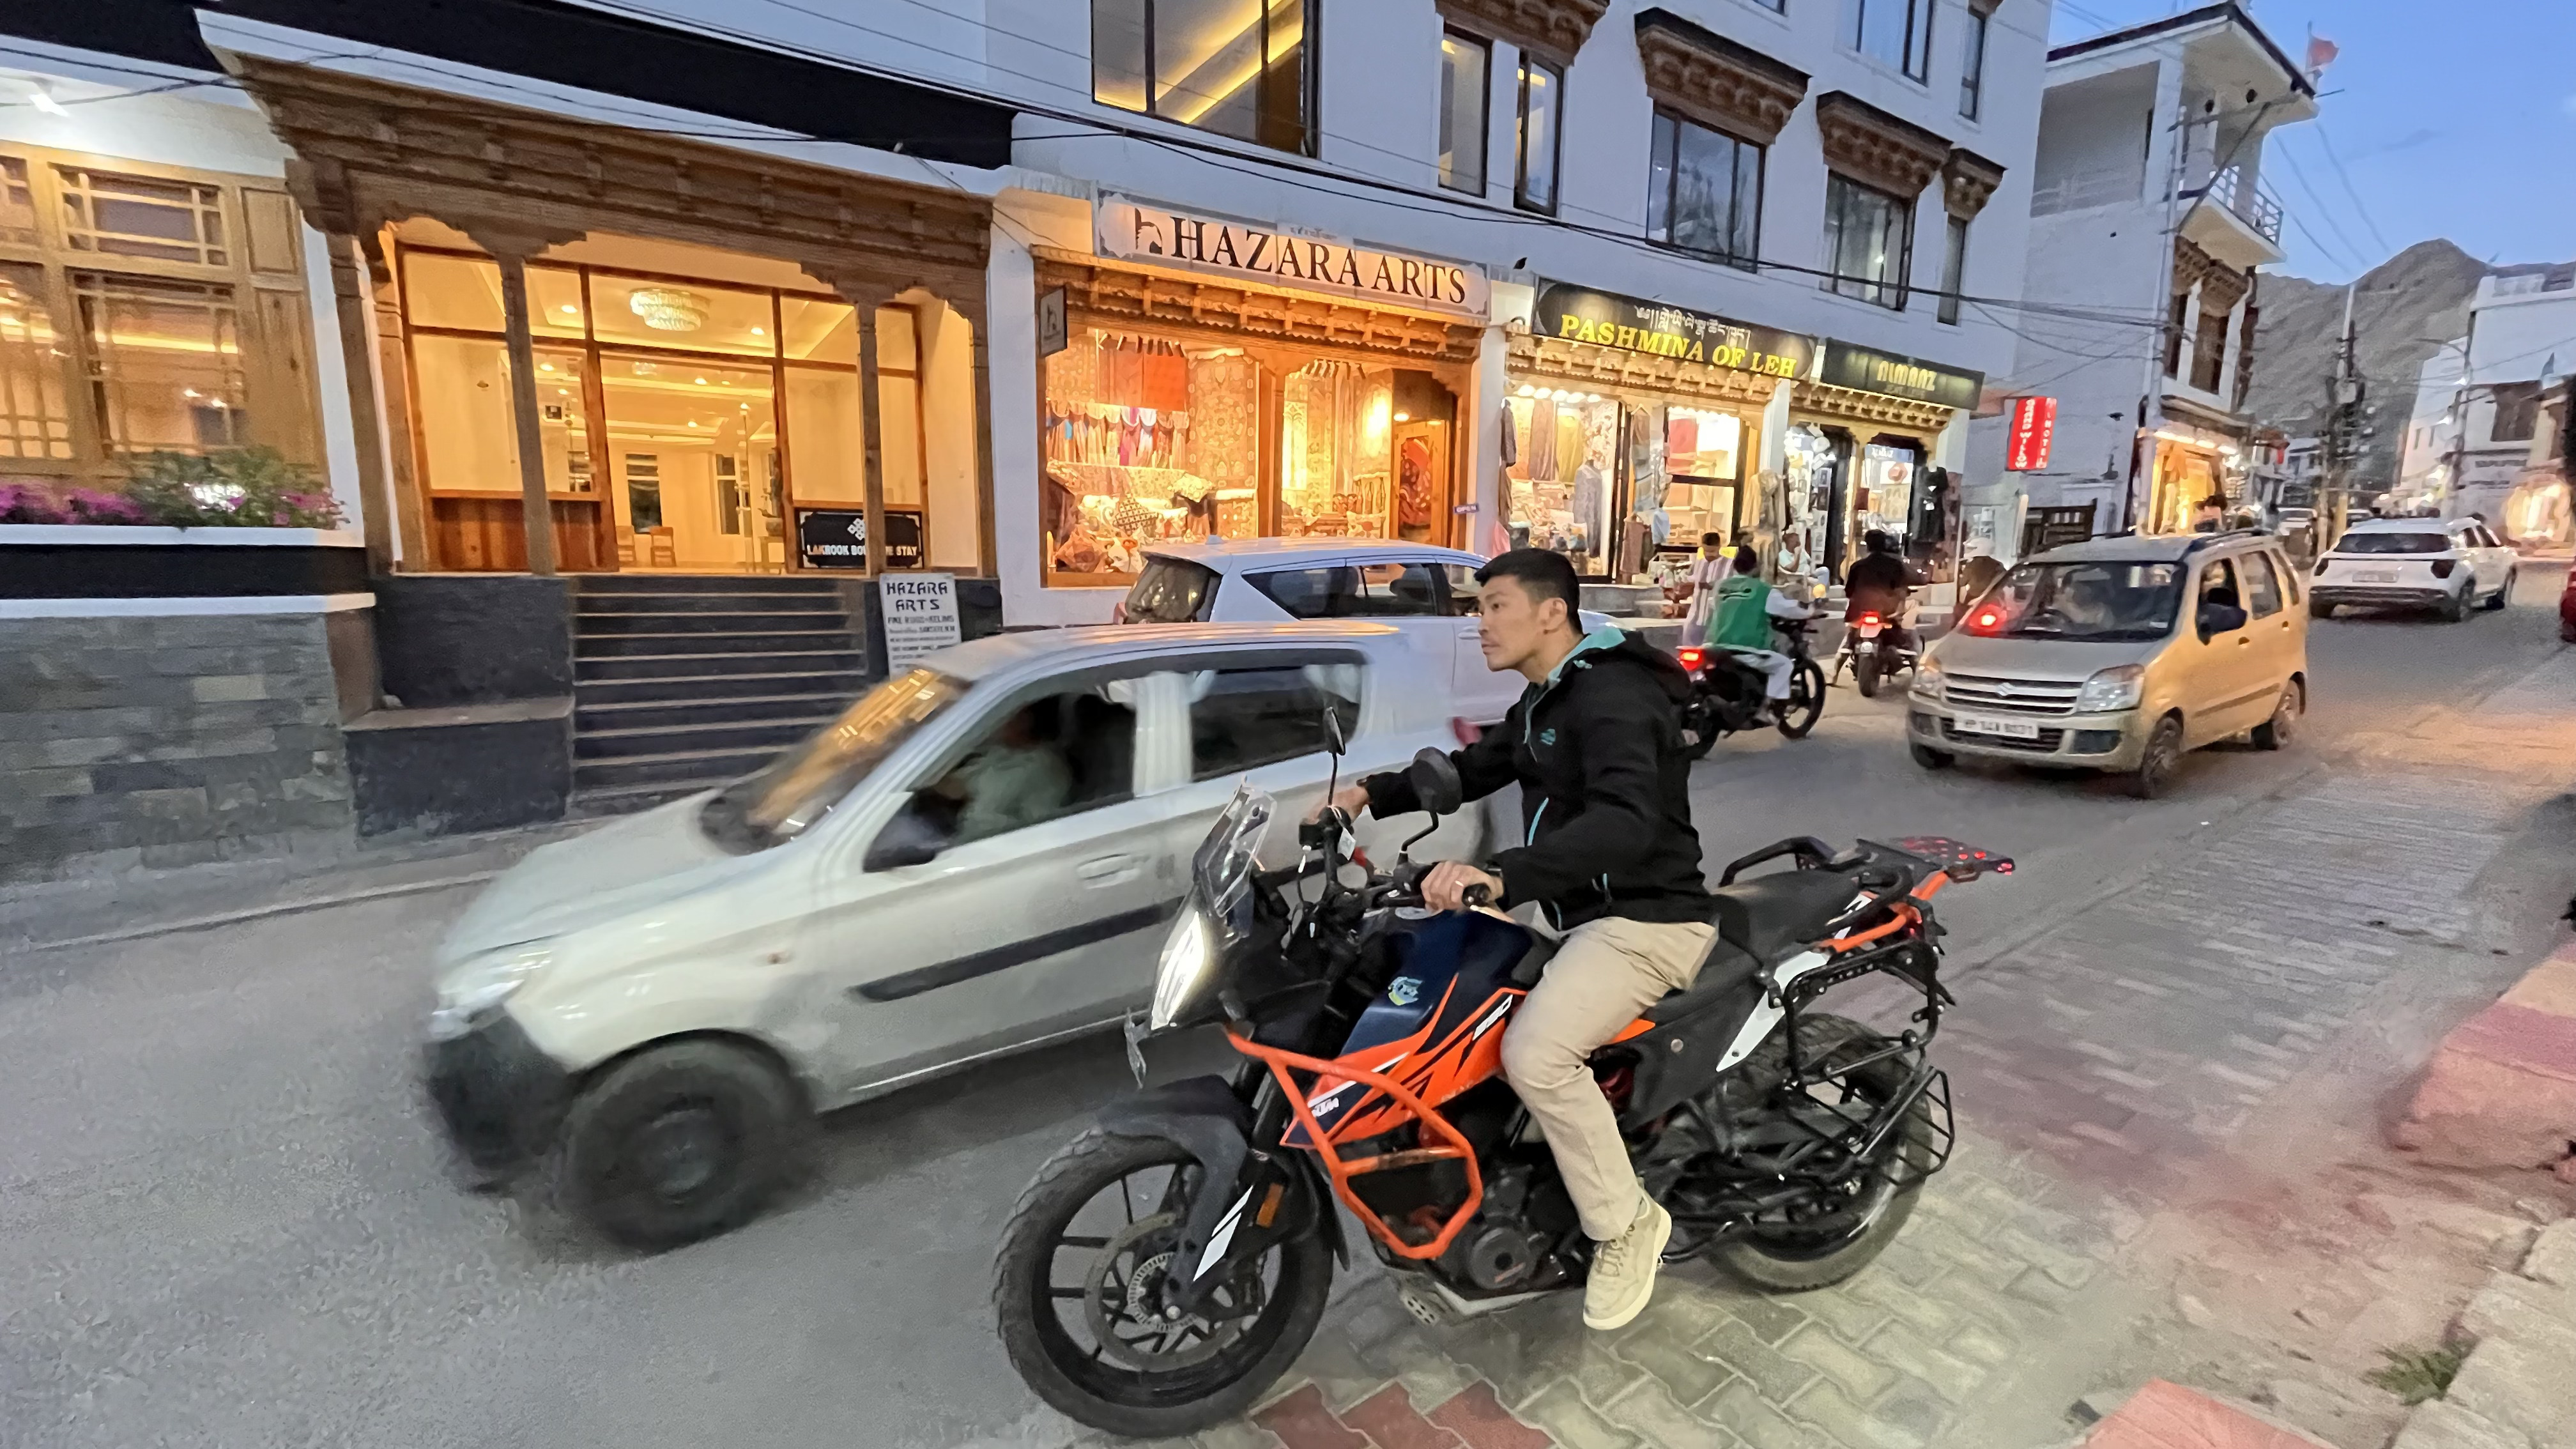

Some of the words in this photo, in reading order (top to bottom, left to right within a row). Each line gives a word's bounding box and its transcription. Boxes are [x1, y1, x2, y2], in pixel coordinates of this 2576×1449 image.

[1170, 216, 1364, 287] HAZARA
[1370, 256, 1465, 303] ARTS
[1559, 314, 1704, 362] PASHMINA
[1712, 344, 1745, 367] OF
[1750, 352, 1797, 378] LEH
[896, 546, 917, 556] STAY
[887, 582, 947, 595] HAZARA
[896, 599, 940, 611] ARTS
[1312, 1097, 1339, 1117] KTM
